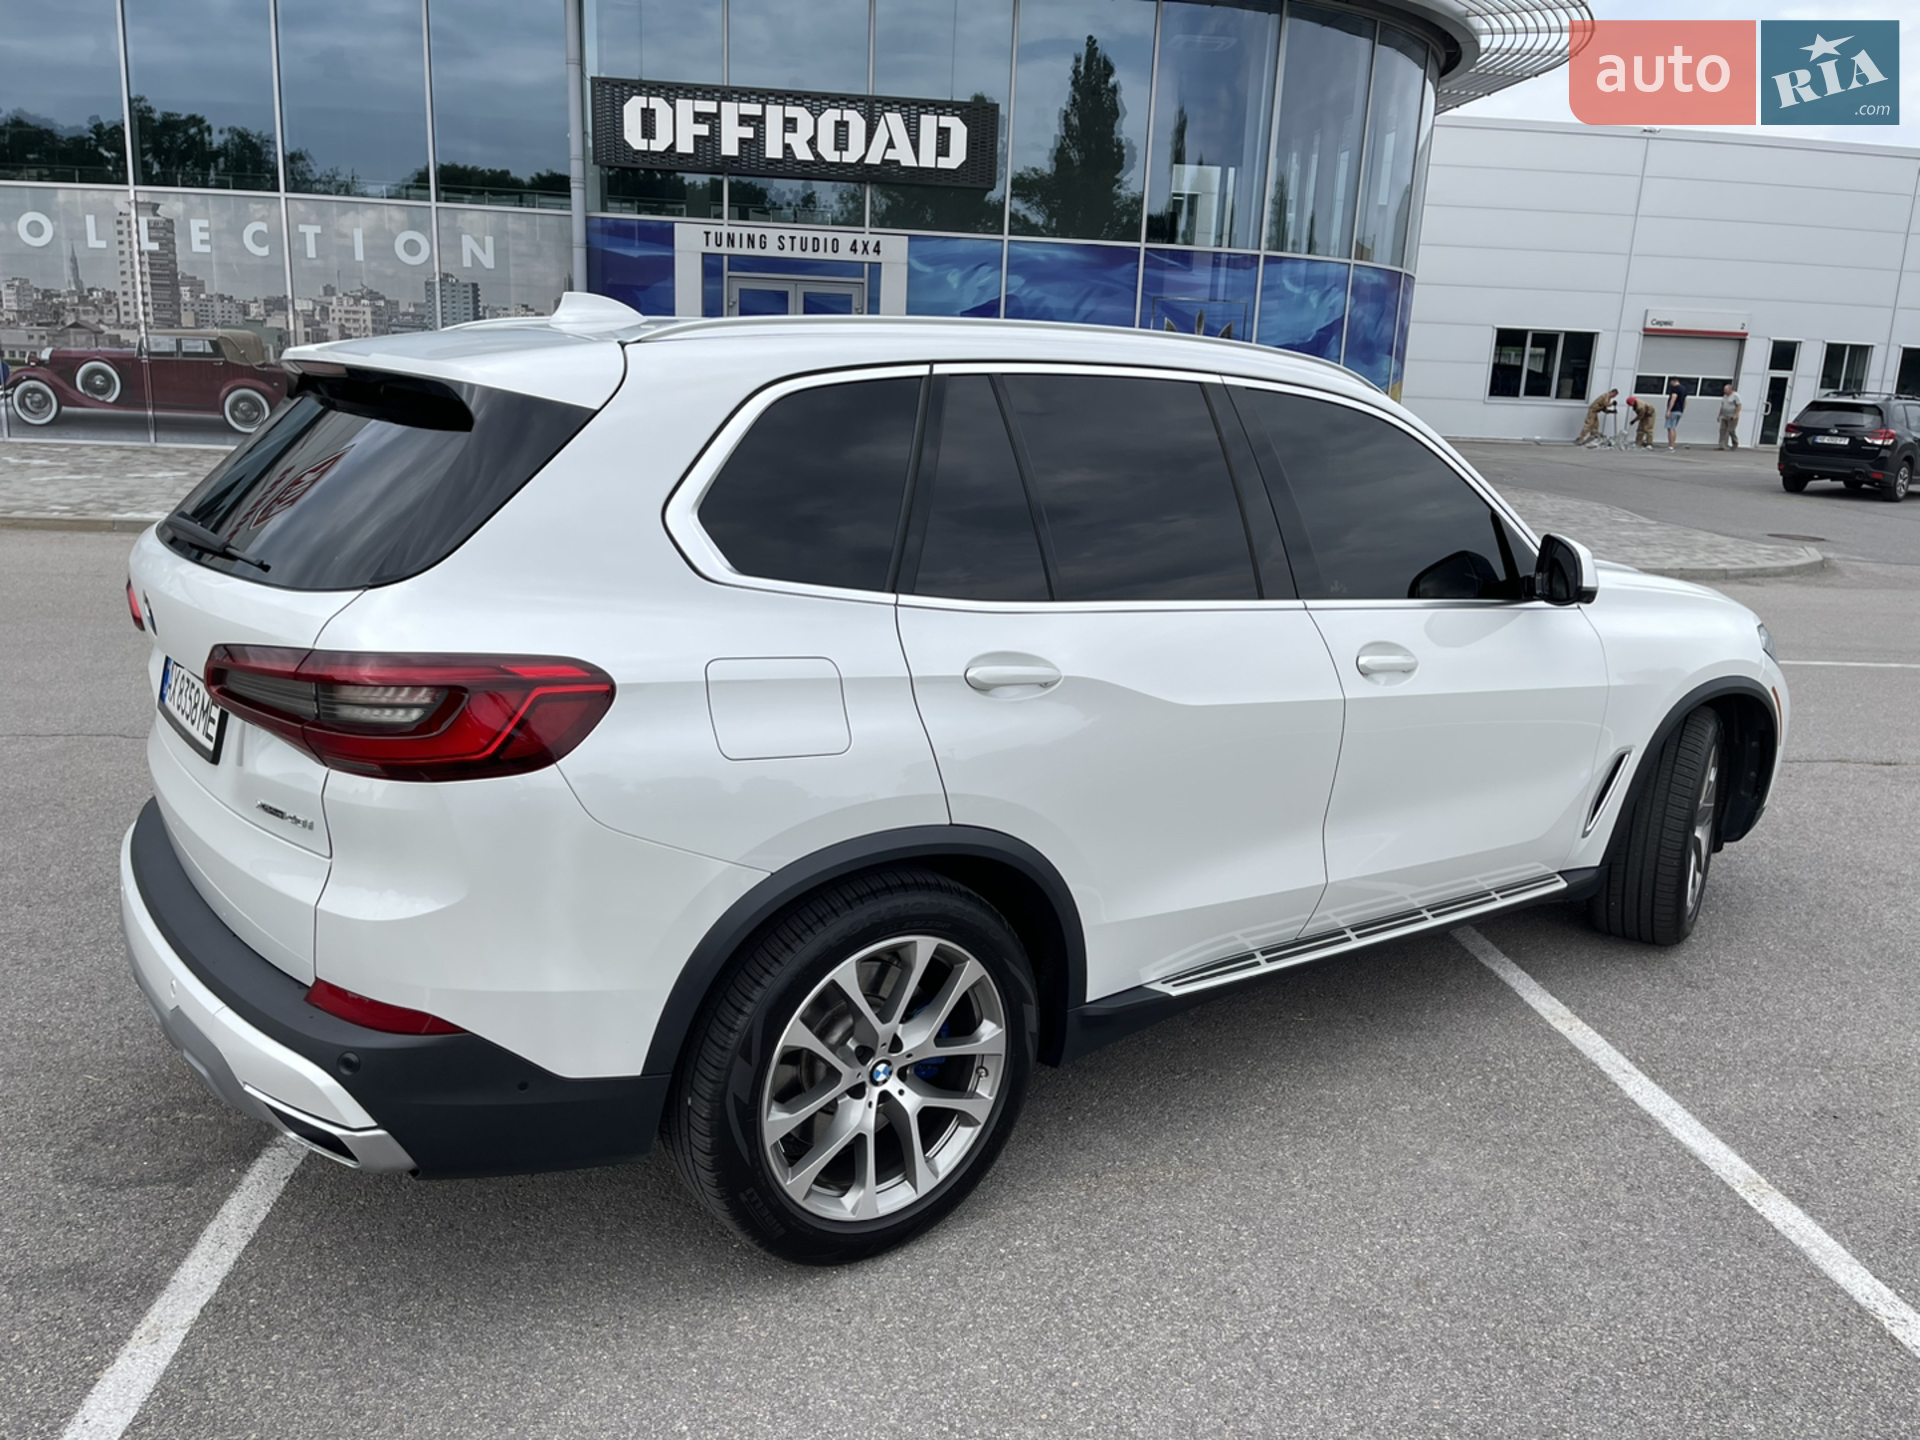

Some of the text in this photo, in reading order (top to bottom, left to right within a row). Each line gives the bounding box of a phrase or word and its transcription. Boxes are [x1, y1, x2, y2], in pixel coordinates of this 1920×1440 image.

[623, 96, 967, 169] OFFROAD
[703, 231, 767, 250] TUNING
[777, 235, 829, 254] STUDIO
[1740, 322, 1746, 330] 2
